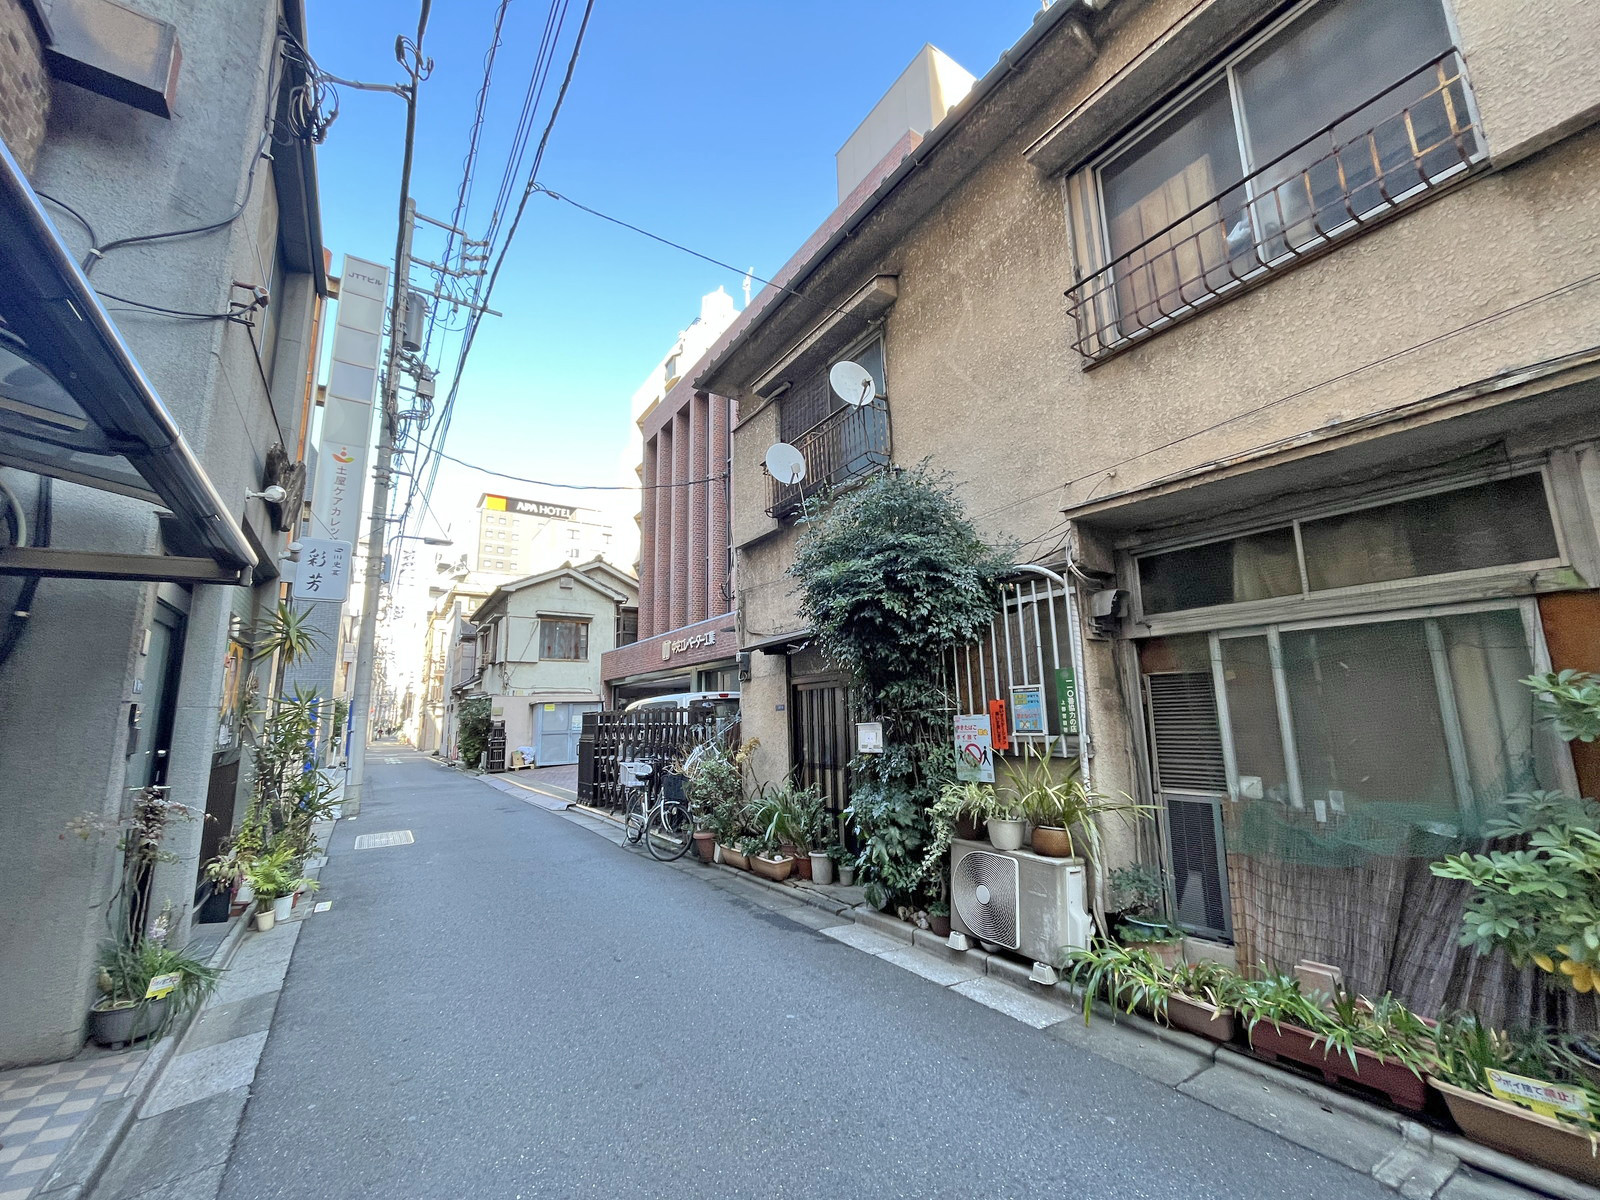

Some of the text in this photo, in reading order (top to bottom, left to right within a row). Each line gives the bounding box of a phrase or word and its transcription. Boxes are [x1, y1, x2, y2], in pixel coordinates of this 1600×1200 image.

[348, 272, 383, 286] JTTビル
[329, 466, 348, 540] 土屋ケアカレッ
[516, 501, 572, 518] APA HOTEL
[305, 548, 327, 592] 彩芳
